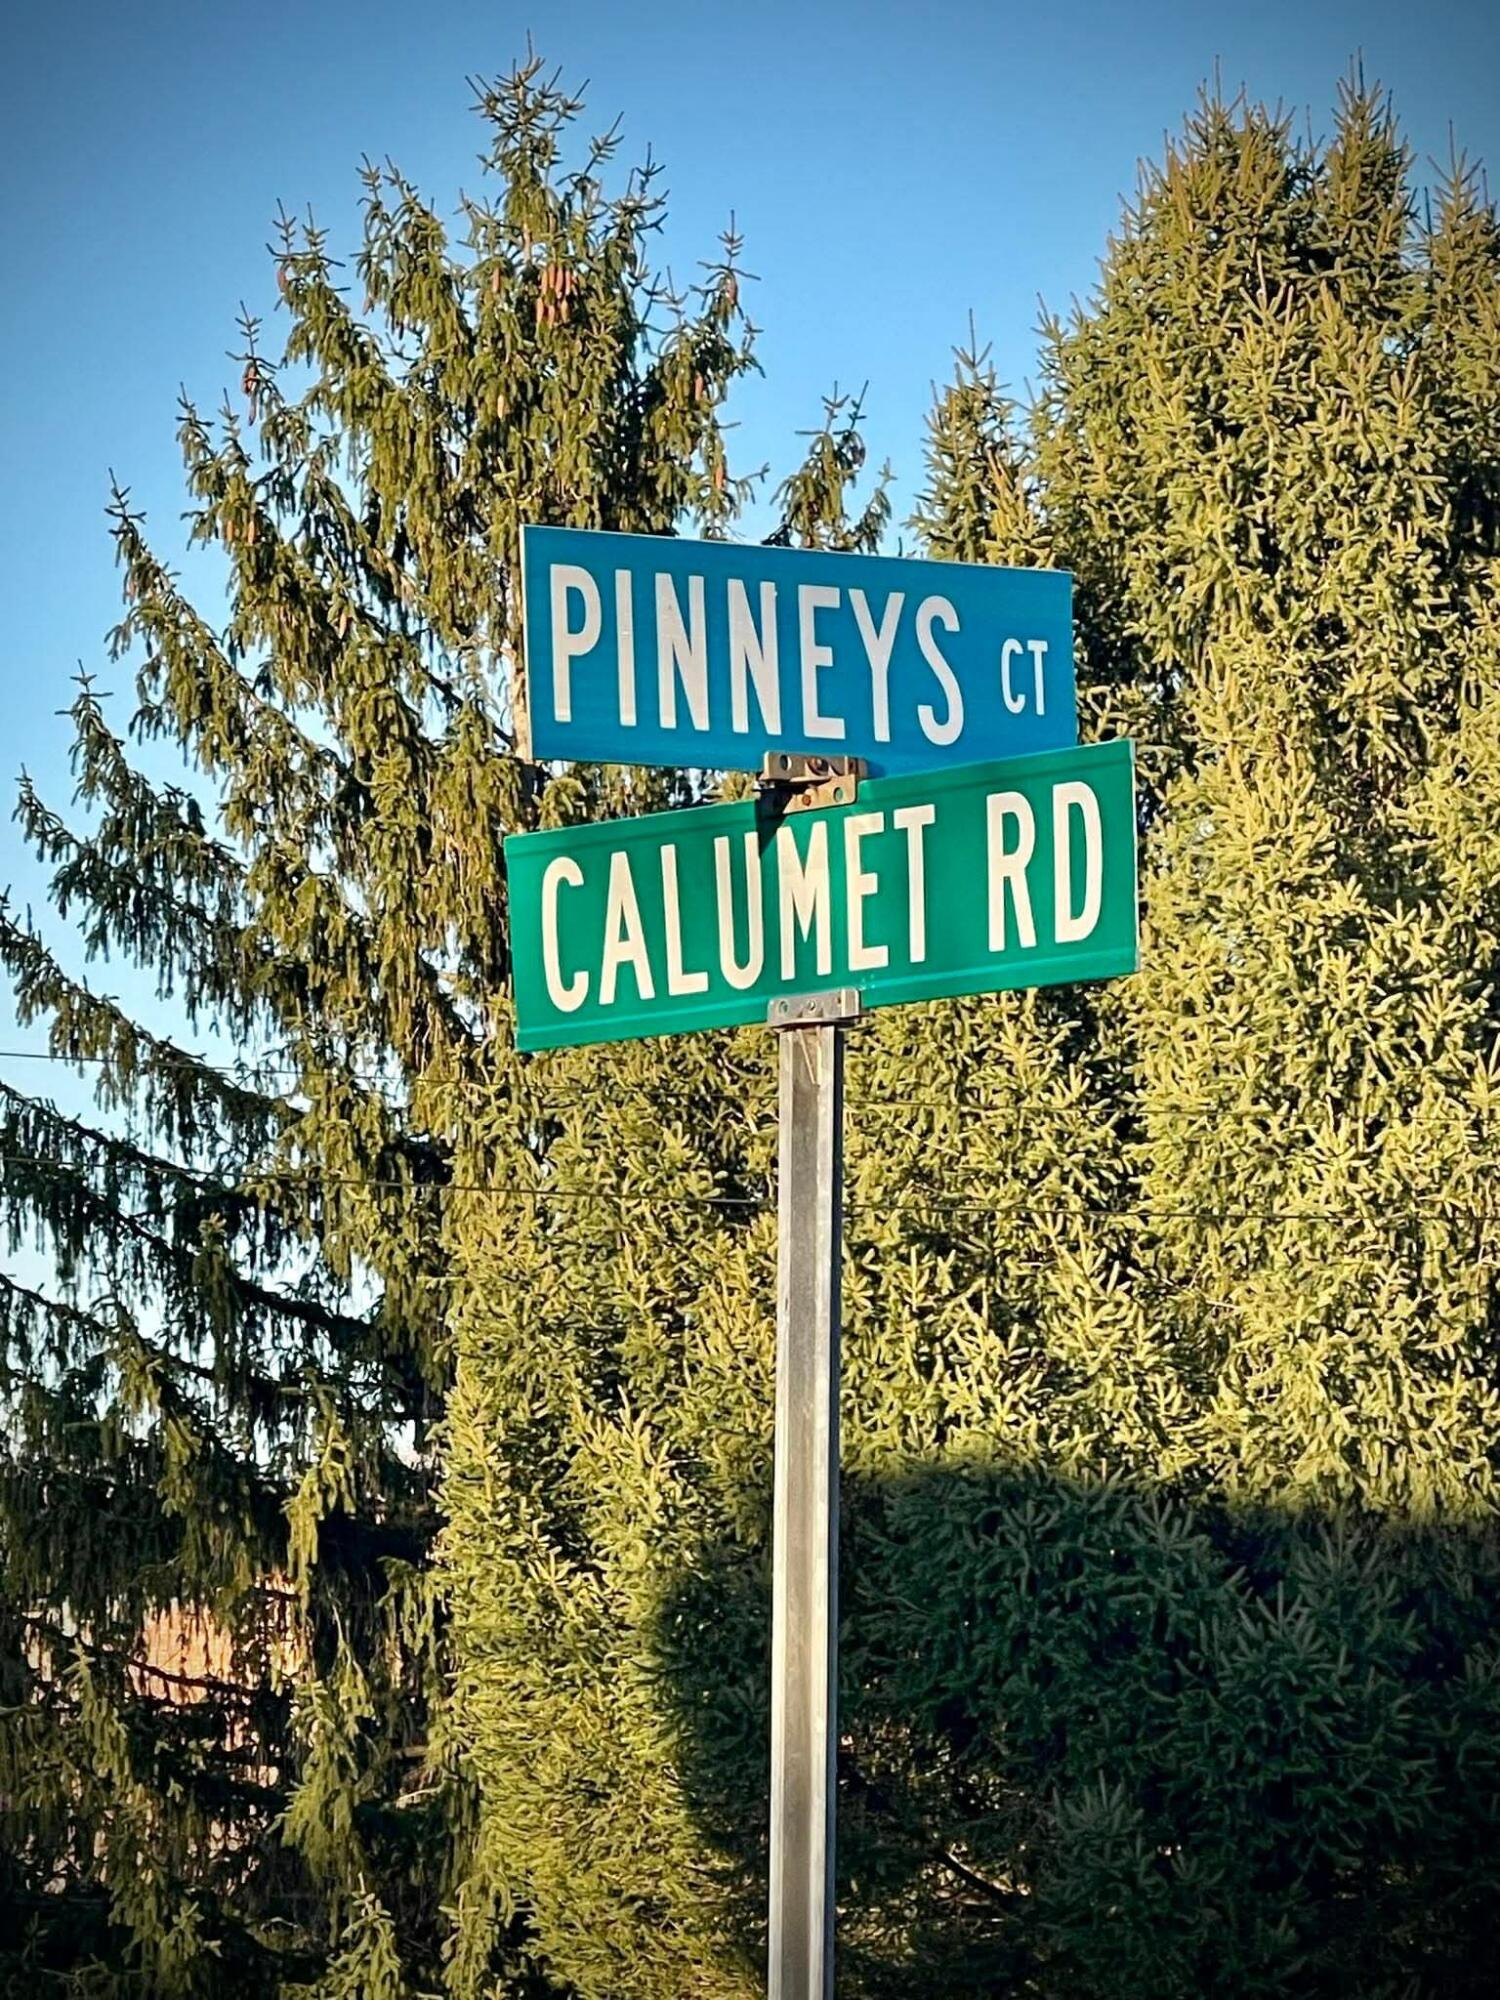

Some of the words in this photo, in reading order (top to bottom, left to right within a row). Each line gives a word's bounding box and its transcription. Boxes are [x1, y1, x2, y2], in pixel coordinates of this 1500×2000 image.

[550, 564, 965, 746] PINNEYS
[1001, 638, 1049, 716] CT
[541, 804, 936, 1013] CALUMET
[986, 781, 1103, 952] RD
